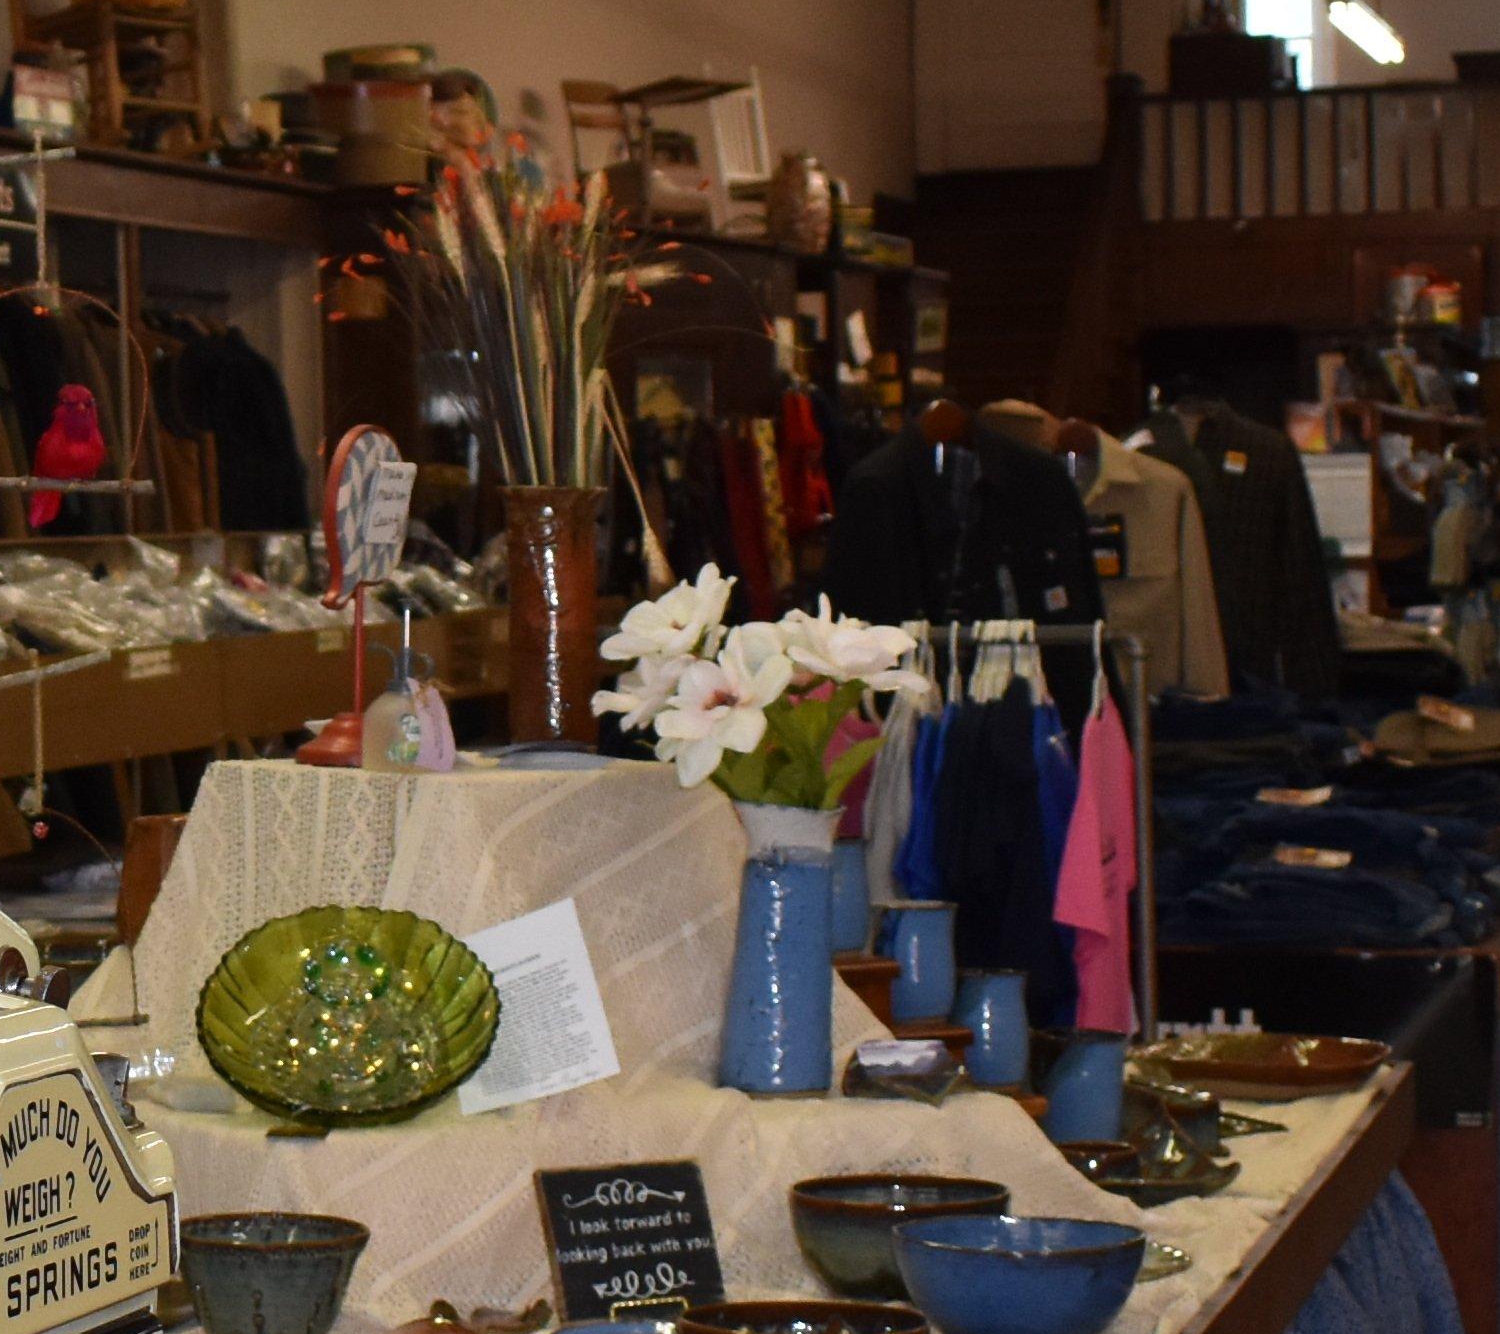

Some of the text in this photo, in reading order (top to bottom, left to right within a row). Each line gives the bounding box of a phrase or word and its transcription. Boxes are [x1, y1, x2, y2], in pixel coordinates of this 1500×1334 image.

[0, 1098, 50, 1167] MUCH
[56, 1100, 80, 1148] DO
[83, 1127, 112, 1203] YOU
[128, 1224, 151, 1242] DROP
[580, 1218, 610, 1235] look
[677, 1210, 692, 1224] to
[31, 1240, 48, 1257] AND
[53, 1225, 91, 1250] FORTUNE
[129, 1243, 150, 1262] COIN
[556, 1245, 608, 1264] looking
[612, 1241, 647, 1259] back
[651, 1237, 681, 1253] with
[7, 1242, 118, 1317] SPRINGS
[129, 1262, 151, 1281] HERE
